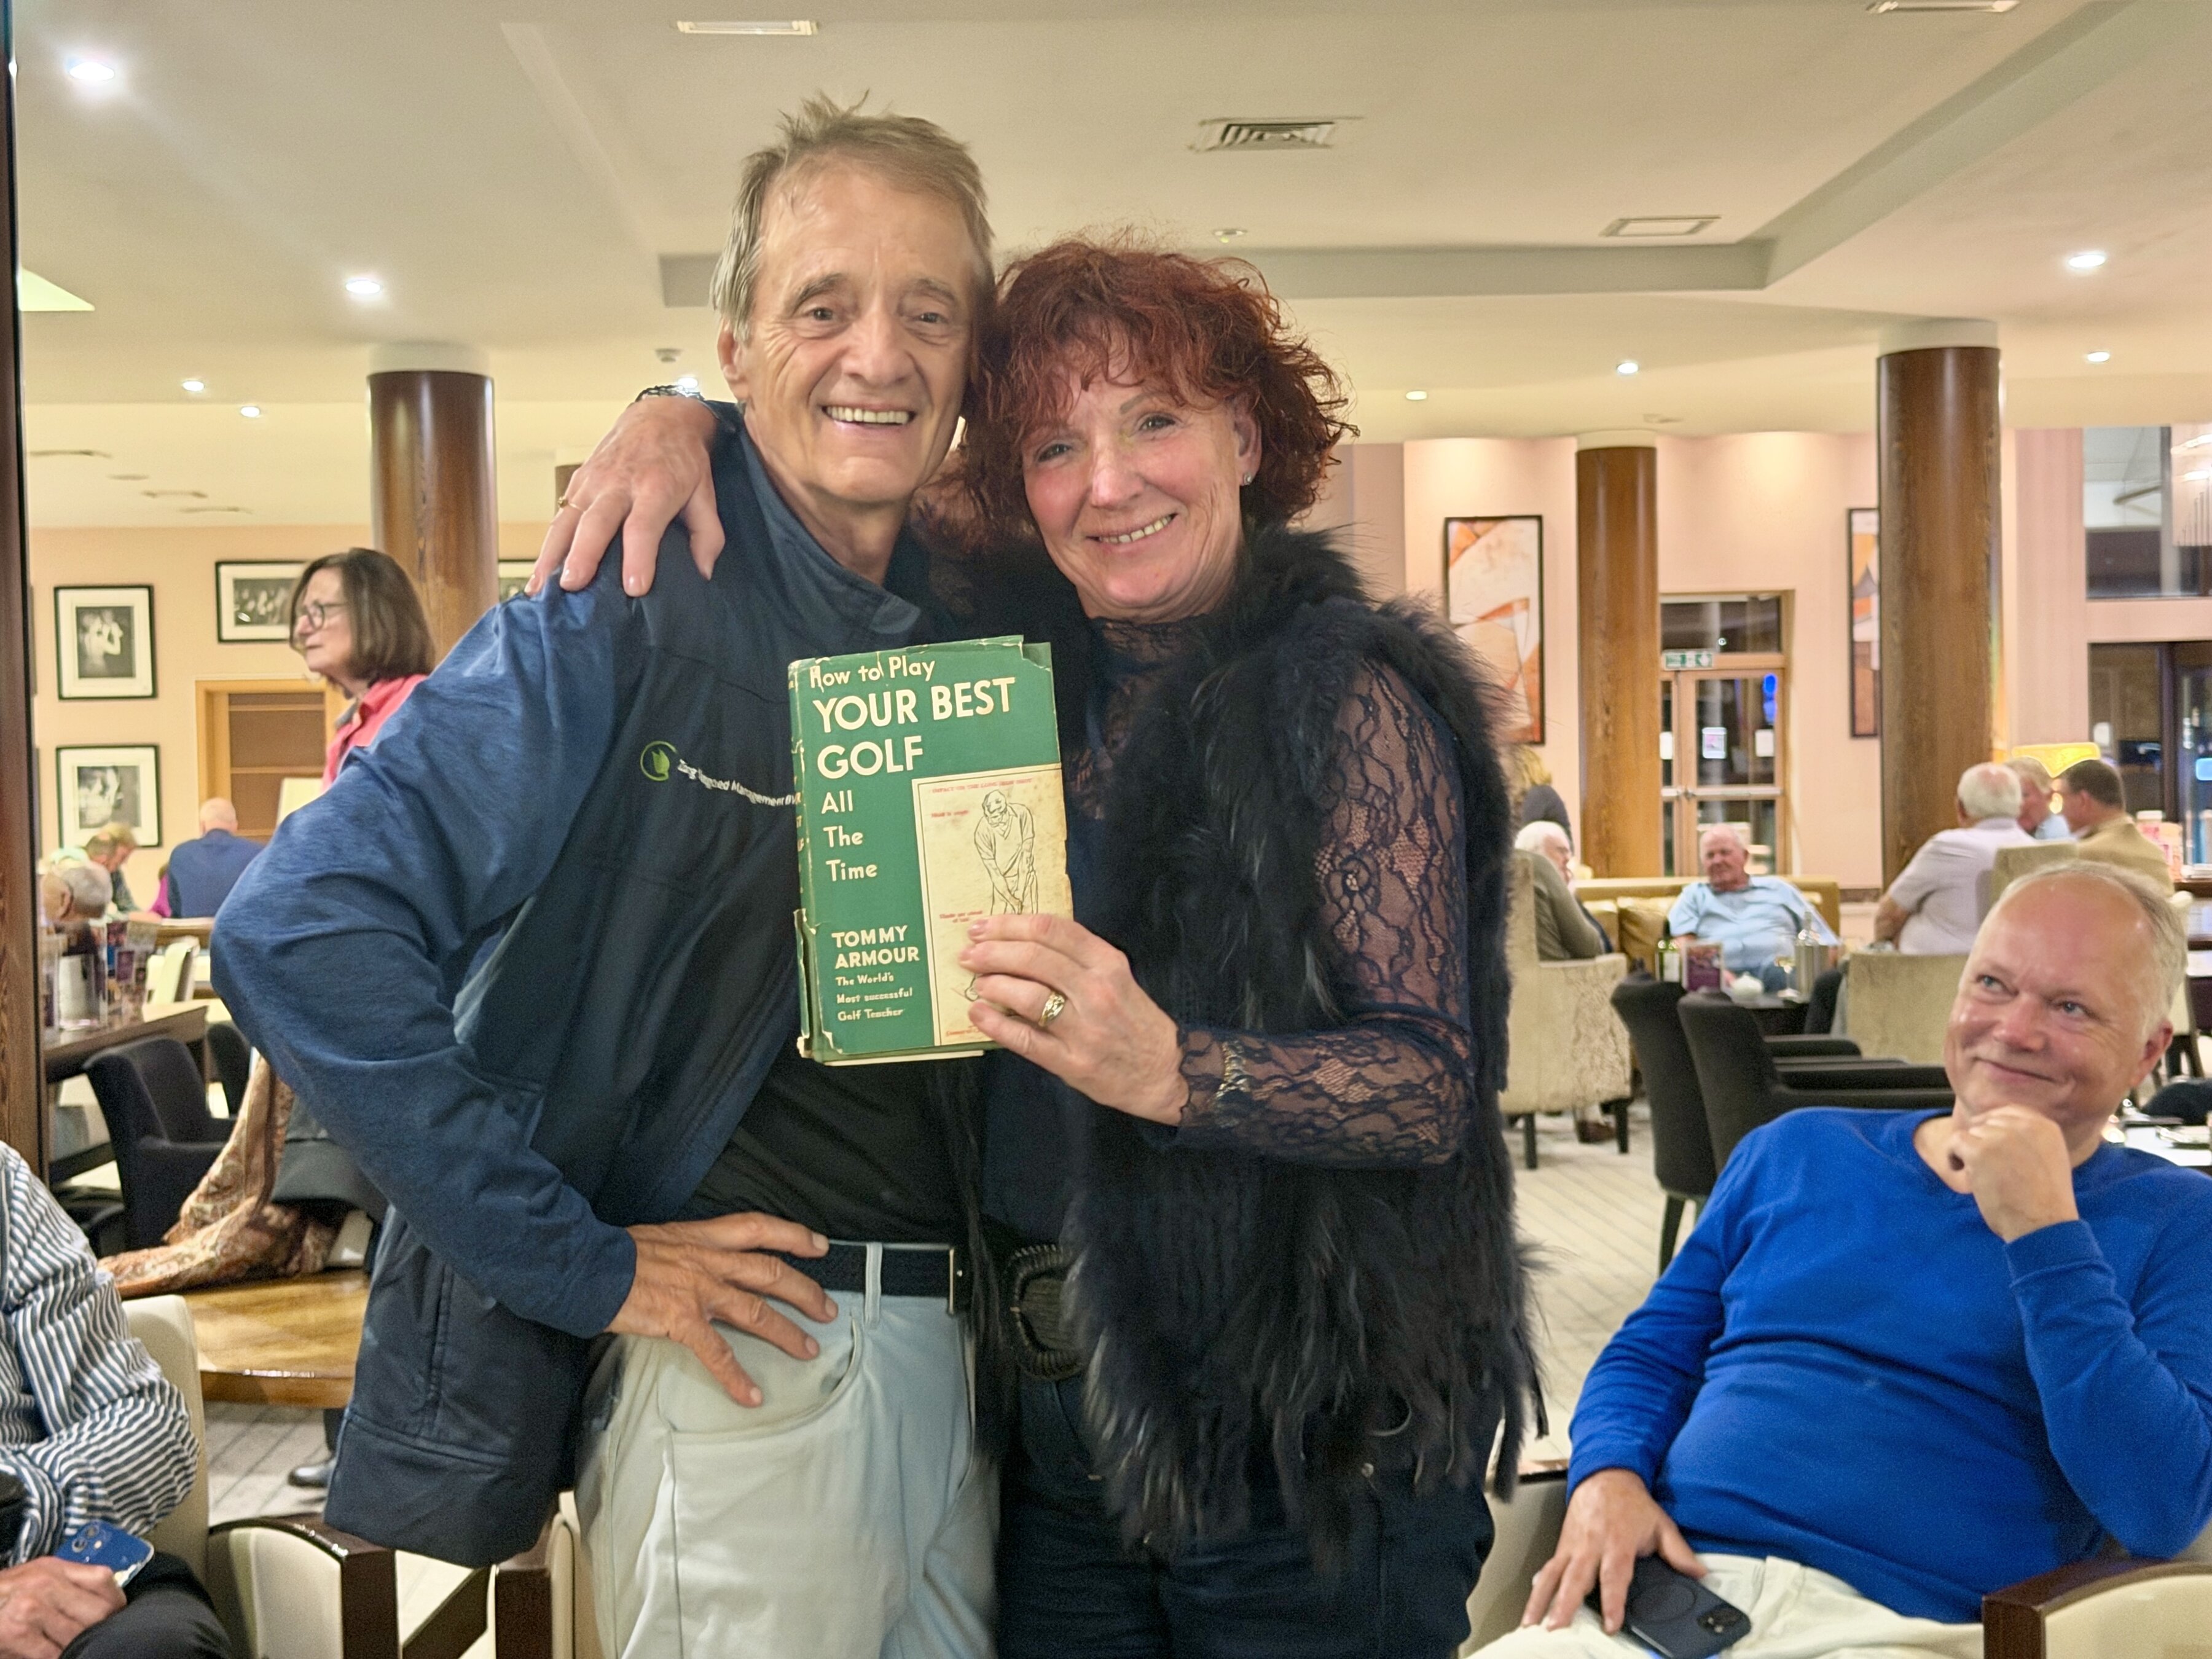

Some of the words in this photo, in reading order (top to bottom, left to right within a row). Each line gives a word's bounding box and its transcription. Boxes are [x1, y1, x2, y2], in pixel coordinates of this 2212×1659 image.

[809, 665, 851, 689] How
[858, 665, 882, 682] to
[888, 655, 935, 681] Play
[812, 689, 919, 733] YOUR
[930, 677, 1016, 721] BEST
[817, 735, 923, 779] GOLF
[821, 790, 853, 814] All
[822, 825, 864, 848] The
[826, 859, 878, 882] Time
[831, 925, 908, 948] TOMMY
[834, 946, 920, 969] ARMOUR
[835, 976, 855, 986] The
[857, 971, 895, 984] World's
[836, 993, 860, 1004] Most
[864, 986, 913, 1002] successful
[837, 1009, 862, 1021] Golf
[863, 1006, 905, 1019] Teacher
